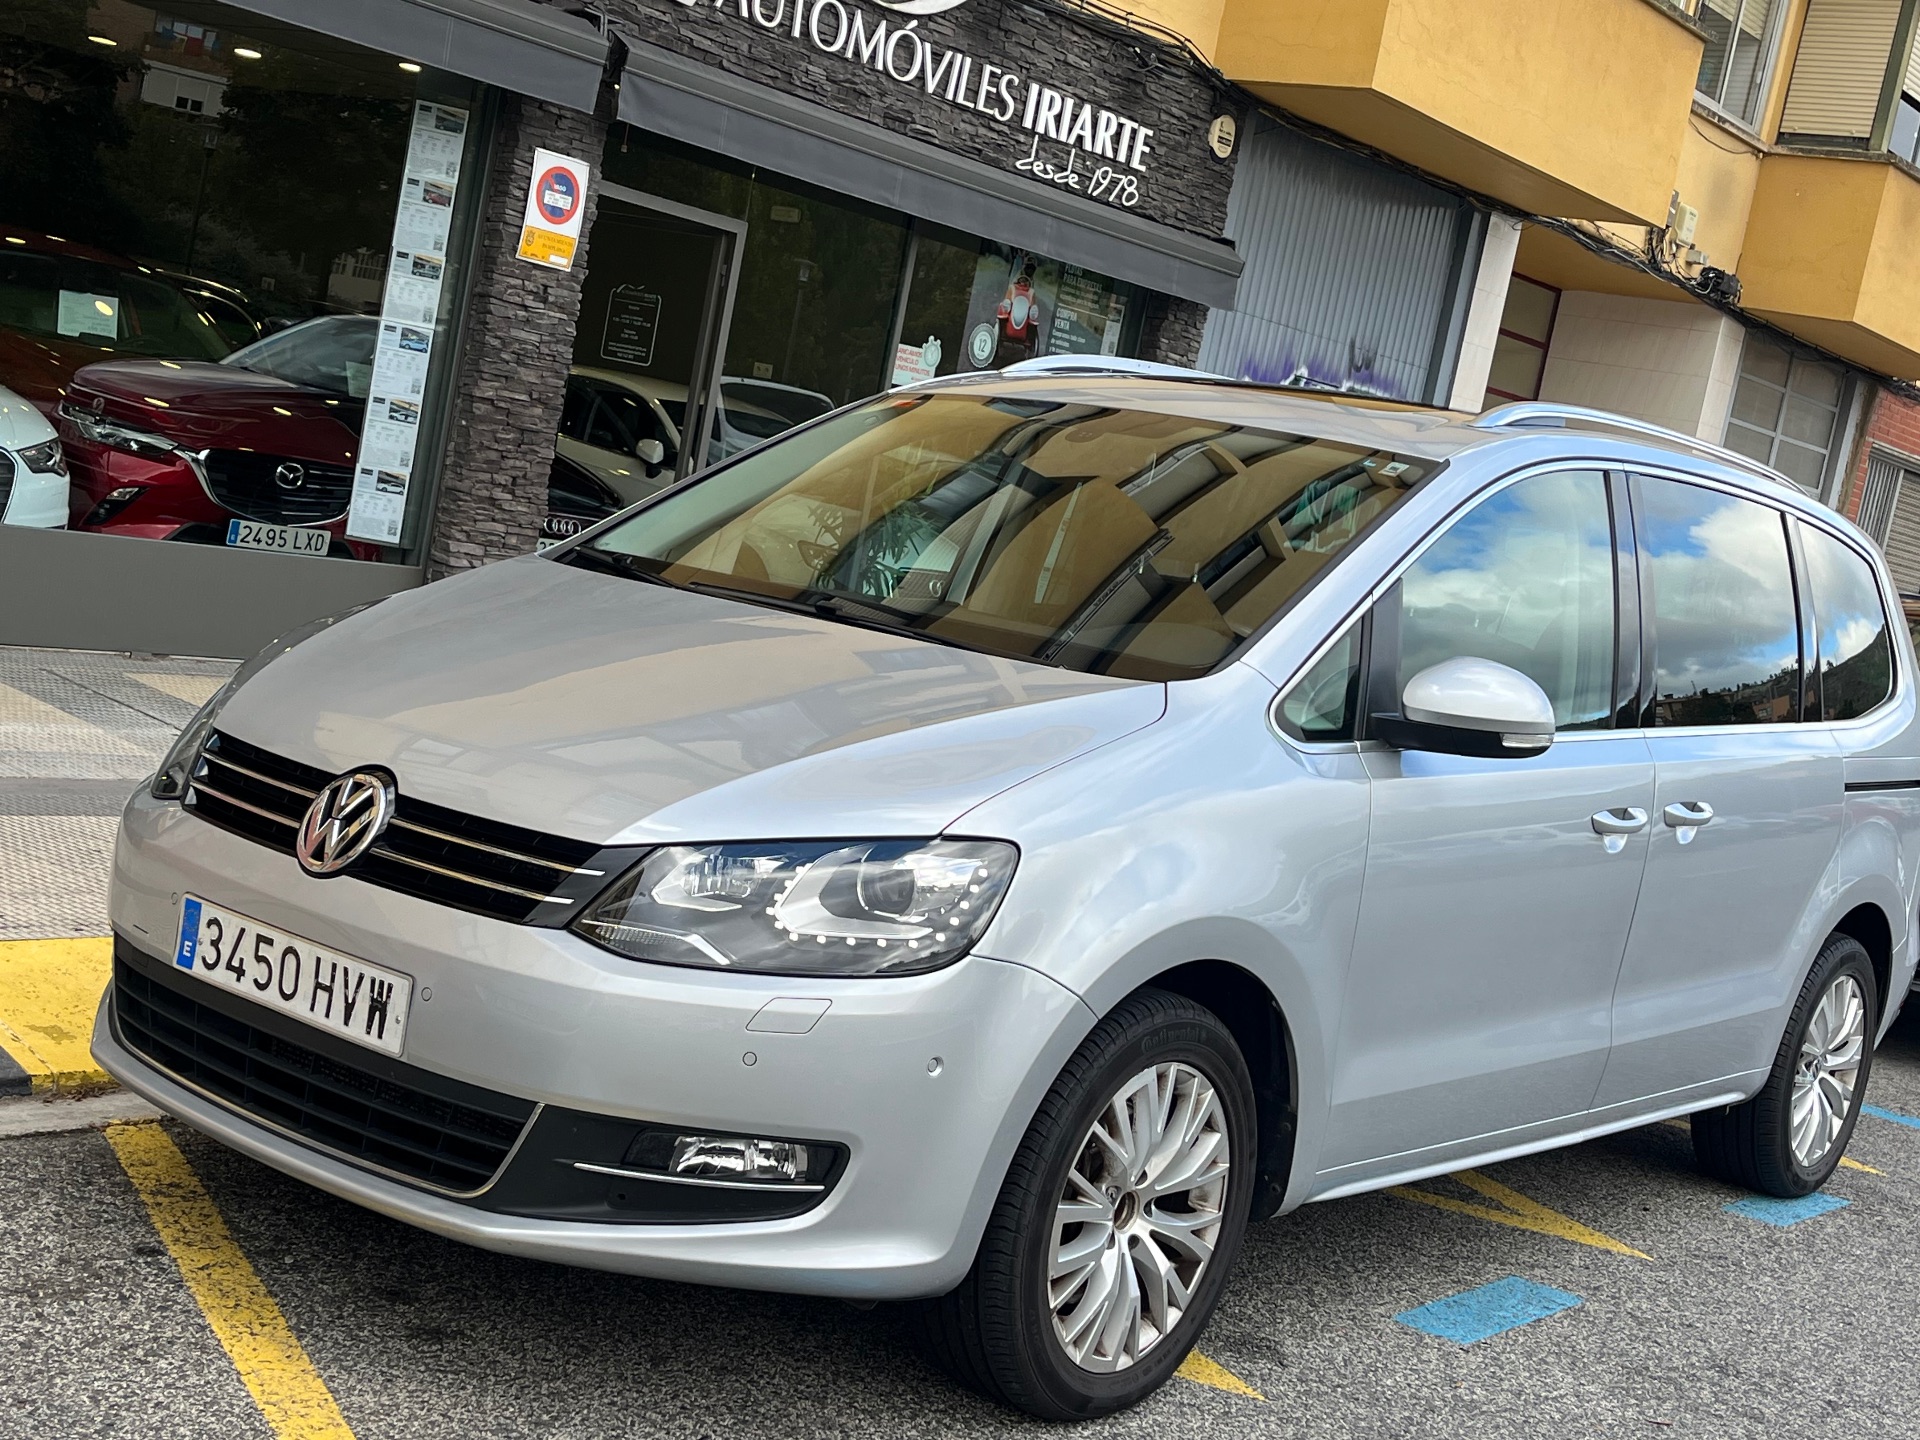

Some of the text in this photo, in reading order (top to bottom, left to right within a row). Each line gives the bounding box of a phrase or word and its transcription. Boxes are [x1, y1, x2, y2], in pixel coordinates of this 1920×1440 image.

[1021, 82, 1154, 173] IRIARTE
[1015, 134, 1139, 207] desde 1978
[1054, 317, 1070, 331] VENTA
[1056, 307, 1078, 322] COMPRA
[978, 338, 988, 353] 12
[239, 524, 288, 548] 2495
[292, 530, 326, 552] LXD
[182, 916, 395, 1041] E 3450 HVW
